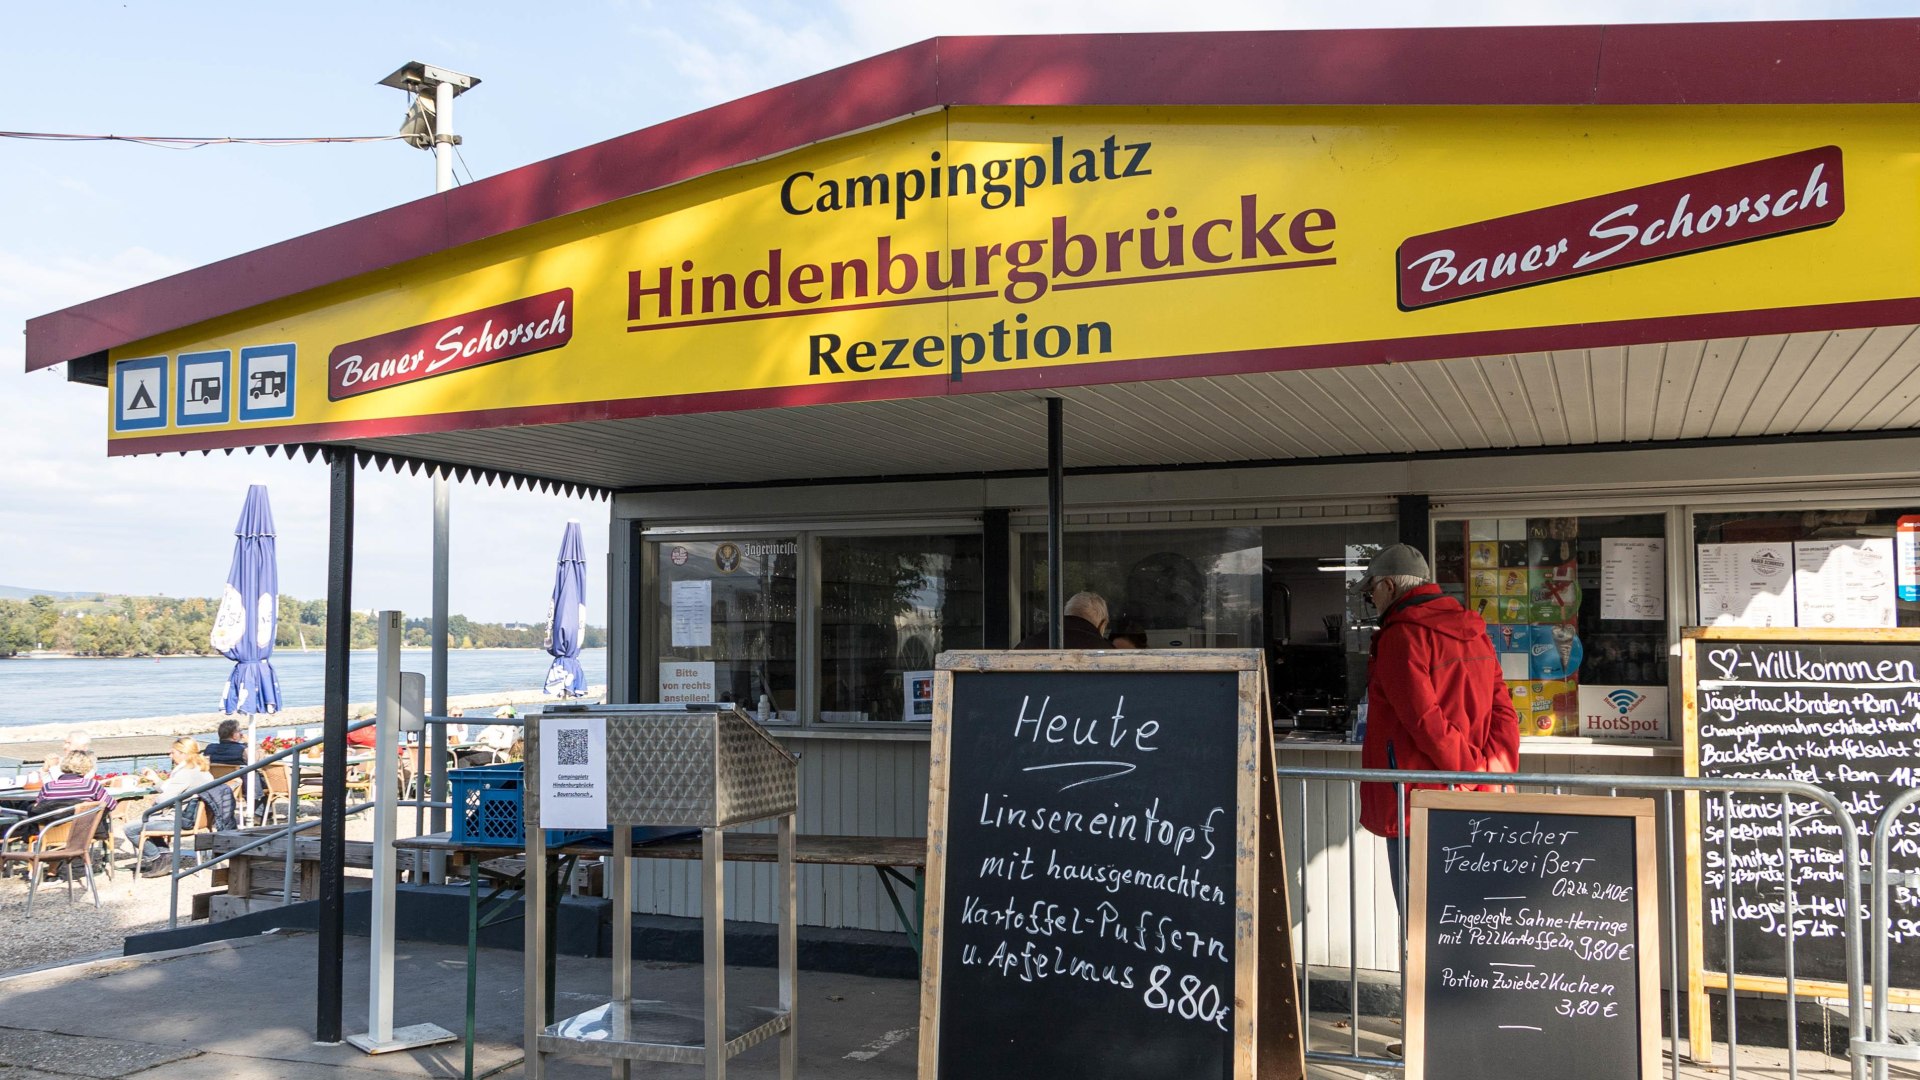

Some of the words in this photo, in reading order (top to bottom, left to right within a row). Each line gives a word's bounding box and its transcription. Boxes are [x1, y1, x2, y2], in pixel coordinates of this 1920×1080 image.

[780, 135, 1152, 219] Campingplatz
[1407, 238, 1568, 293] Bauer
[1572, 162, 1829, 269] Schorsch
[627, 194, 1337, 321] Hindenburgbrücke
[336, 349, 424, 387] Bauer
[424, 300, 566, 373] Schorsch
[809, 312, 1113, 382] Rezeption
[675, 668, 698, 677] Bitte
[681, 681, 712, 690] rechts
[664, 693, 710, 702] anstellen!
[1701, 688, 1853, 722] Jägerhackbraten
[1013, 695, 1159, 751] Heute
[1586, 715, 1659, 734] HotSpot
[1700, 739, 1799, 767] Backfisch
[1838, 763, 1880, 784] Pom
[1706, 796, 1820, 822] Itlienisher
[1823, 790, 1883, 815] alat
[979, 793, 1225, 859] Linseneintopf
[1469, 817, 1579, 845] Frischer
[1704, 820, 1803, 844] Speßbratn
[979, 847, 1034, 879] mit
[1046, 849, 1226, 905] hausgemachten
[1442, 845, 1596, 879] Federweißer
[1439, 904, 1513, 928] Eingelegte
[1515, 908, 1628, 936] Sahne-Heringe
[1811, 895, 1872, 918] Hells
[1438, 930, 1462, 945] mit
[962, 946, 981, 966] u.
[988, 941, 1135, 988] Apfelmus
[1143, 964, 1230, 1032] 8,80€
[1442, 967, 1489, 989] Portion
